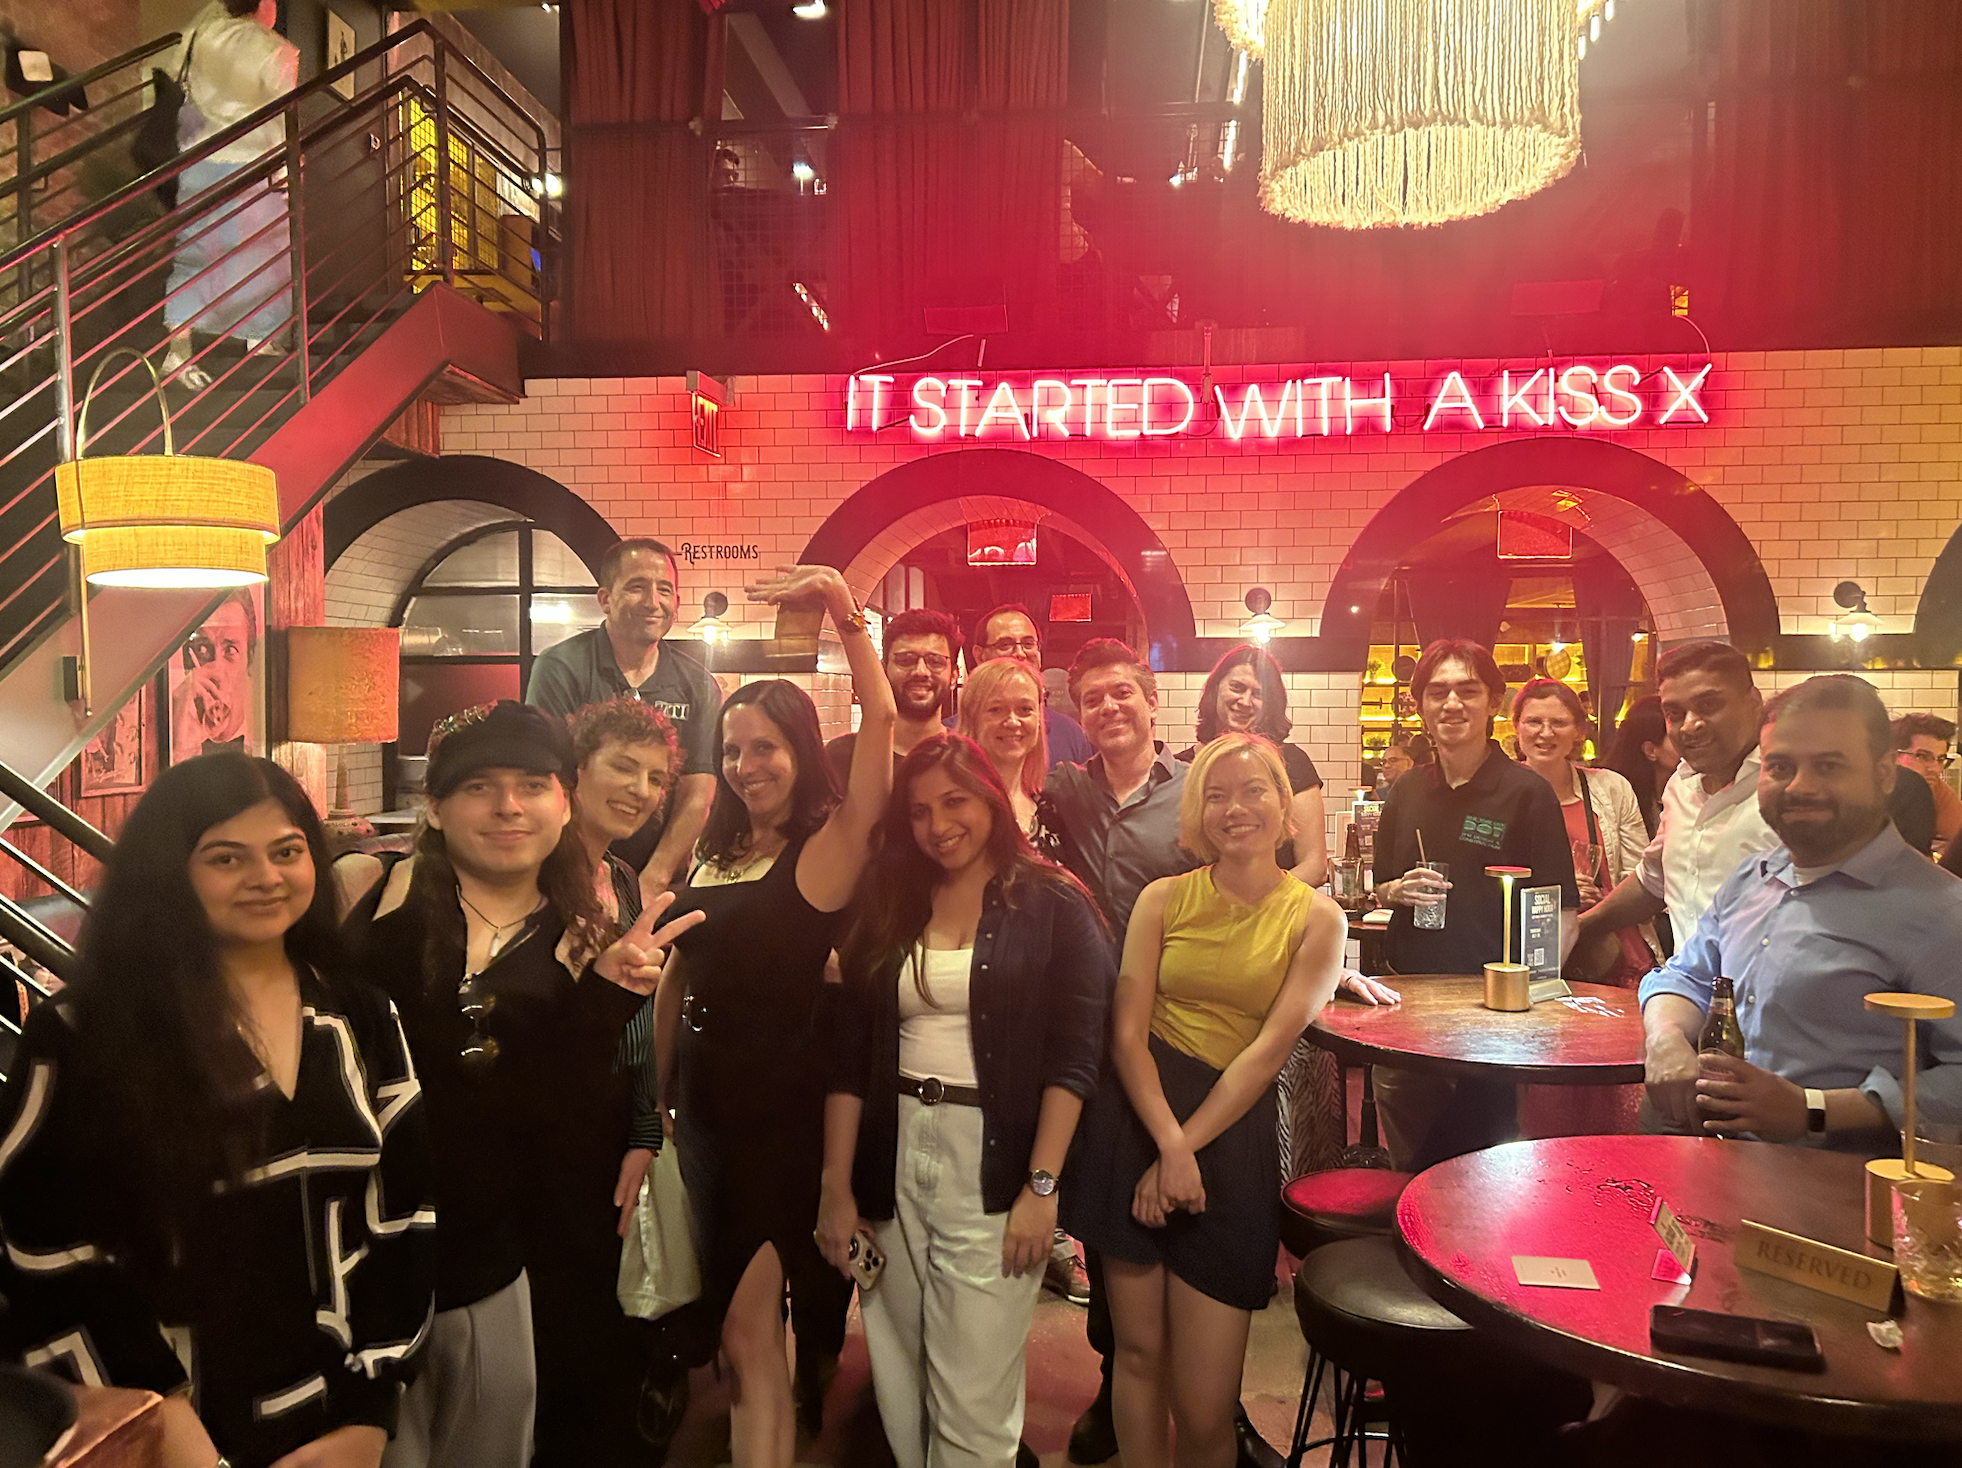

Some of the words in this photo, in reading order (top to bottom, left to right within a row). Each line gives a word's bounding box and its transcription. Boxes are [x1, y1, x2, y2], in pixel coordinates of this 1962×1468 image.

[846, 374, 894, 432] IT
[909, 377, 1194, 440] STARTED
[1213, 372, 1392, 439] WITH
[1422, 371, 1485, 430] A
[1502, 364, 1642, 428] KISS
[1658, 362, 1713, 425] X
[681, 543, 758, 565] RESTROOMS
[1534, 893, 1550, 906] SOCIAL
[1757, 1240, 1872, 1290] RESERVED
